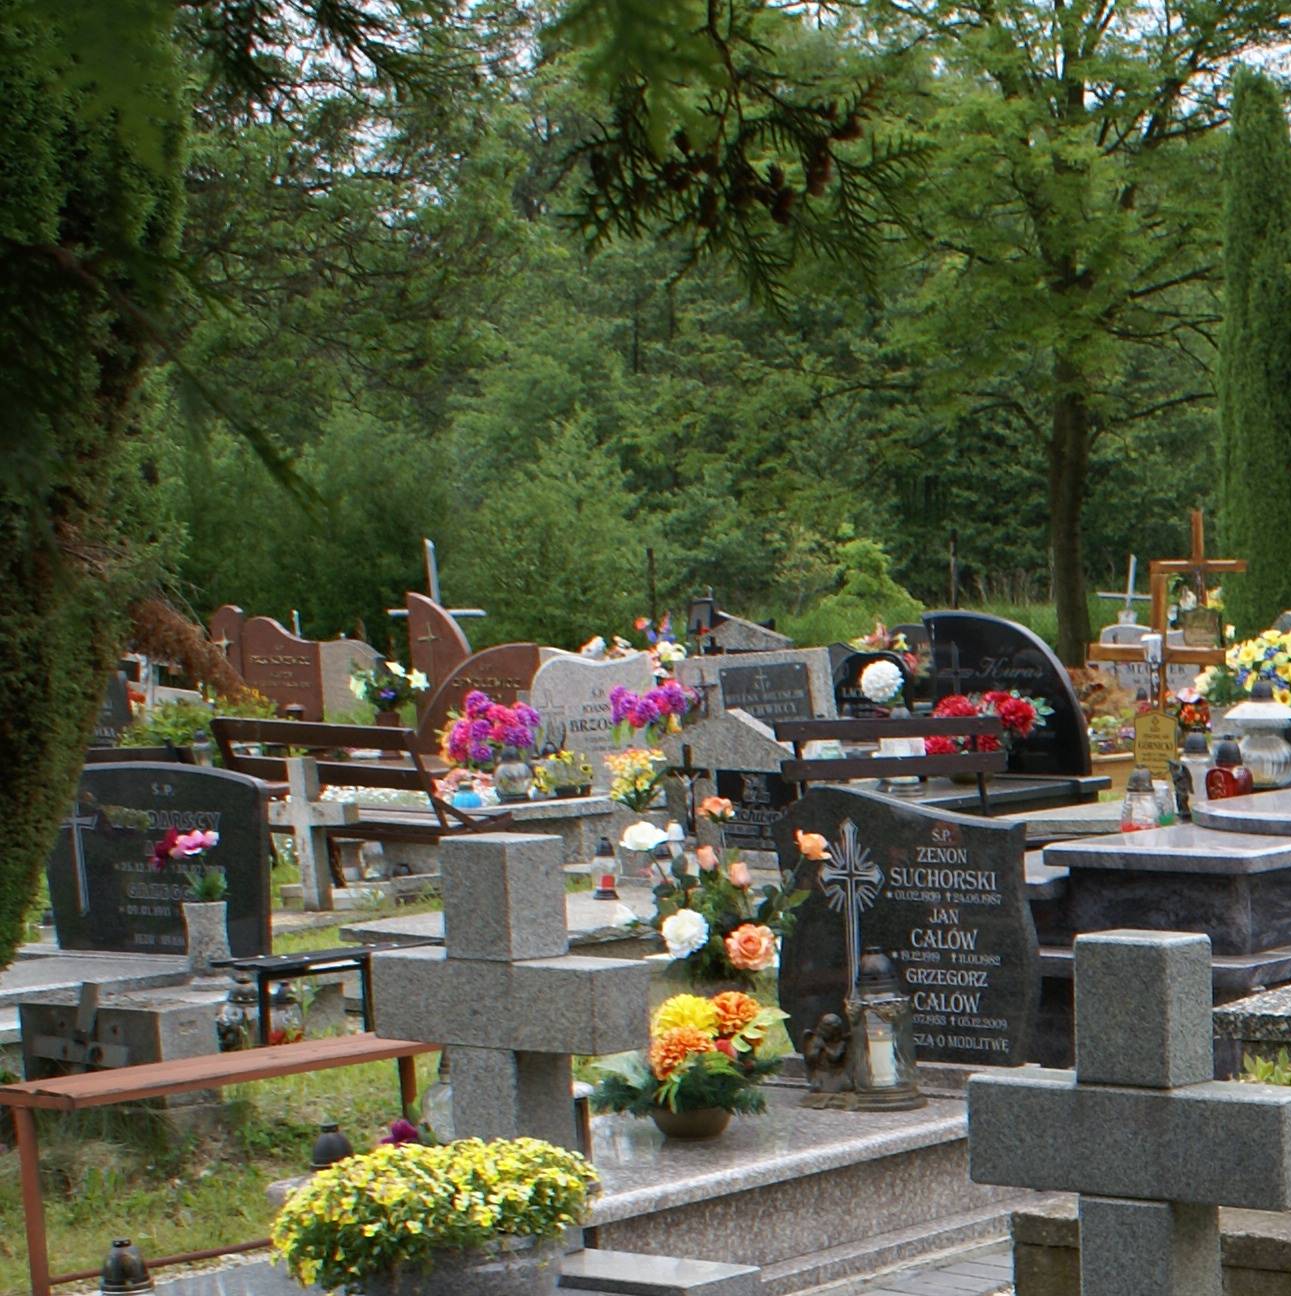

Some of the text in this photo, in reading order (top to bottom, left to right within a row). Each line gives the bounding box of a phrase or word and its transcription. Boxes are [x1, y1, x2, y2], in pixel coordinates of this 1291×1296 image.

[916, 846, 967, 864] ZENON
[890, 866, 998, 890] SUCHORSKI
[929, 908, 960, 924] JAN
[905, 967, 989, 987] GRZEGORZ
